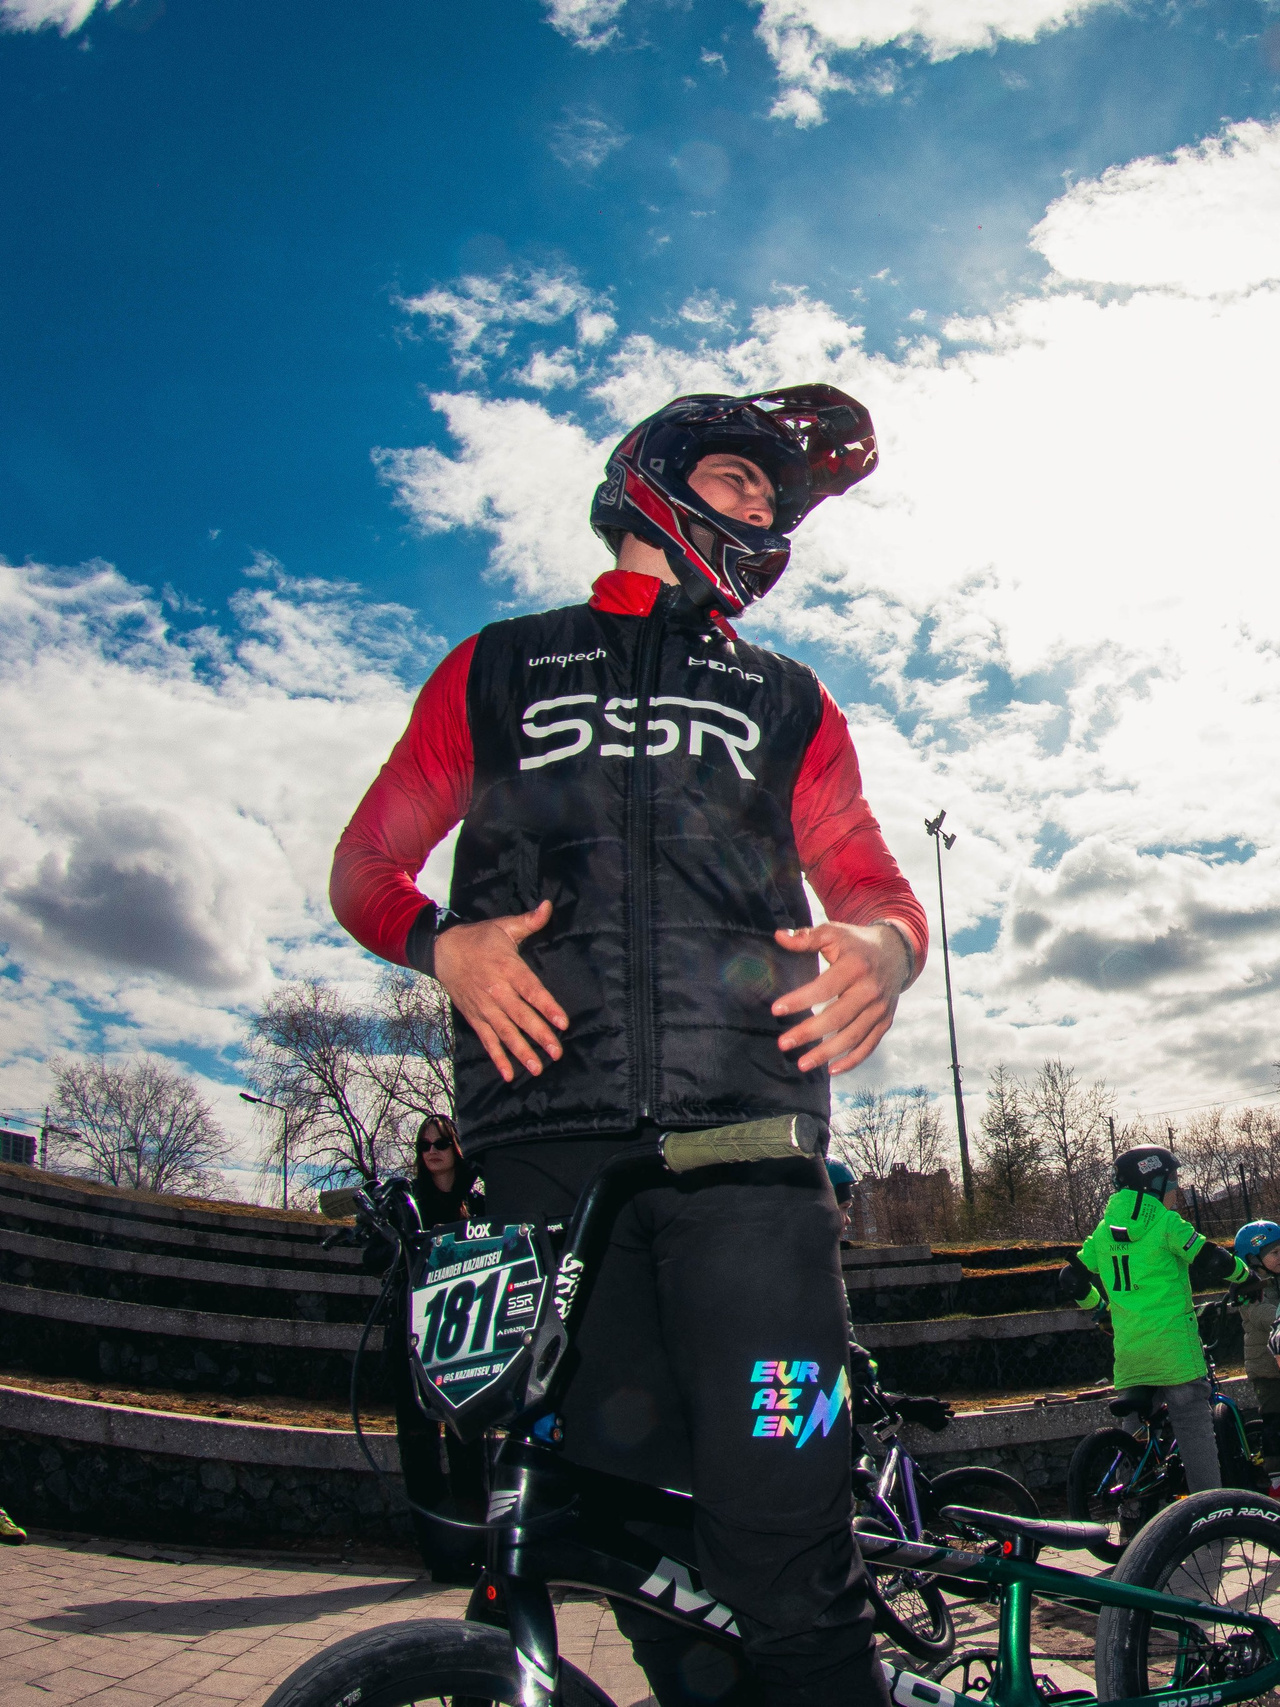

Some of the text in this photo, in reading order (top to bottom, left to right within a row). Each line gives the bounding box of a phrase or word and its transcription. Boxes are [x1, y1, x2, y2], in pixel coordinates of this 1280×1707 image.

[528, 648, 608, 668] uniqtech
[519, 694, 761, 781] SSR
[465, 1221, 491, 1239] box
[426, 1250, 502, 1285] ALEXANDER KAZANTSEV
[508, 1294, 533, 1310] SSR
[420, 1269, 501, 1366] 181
